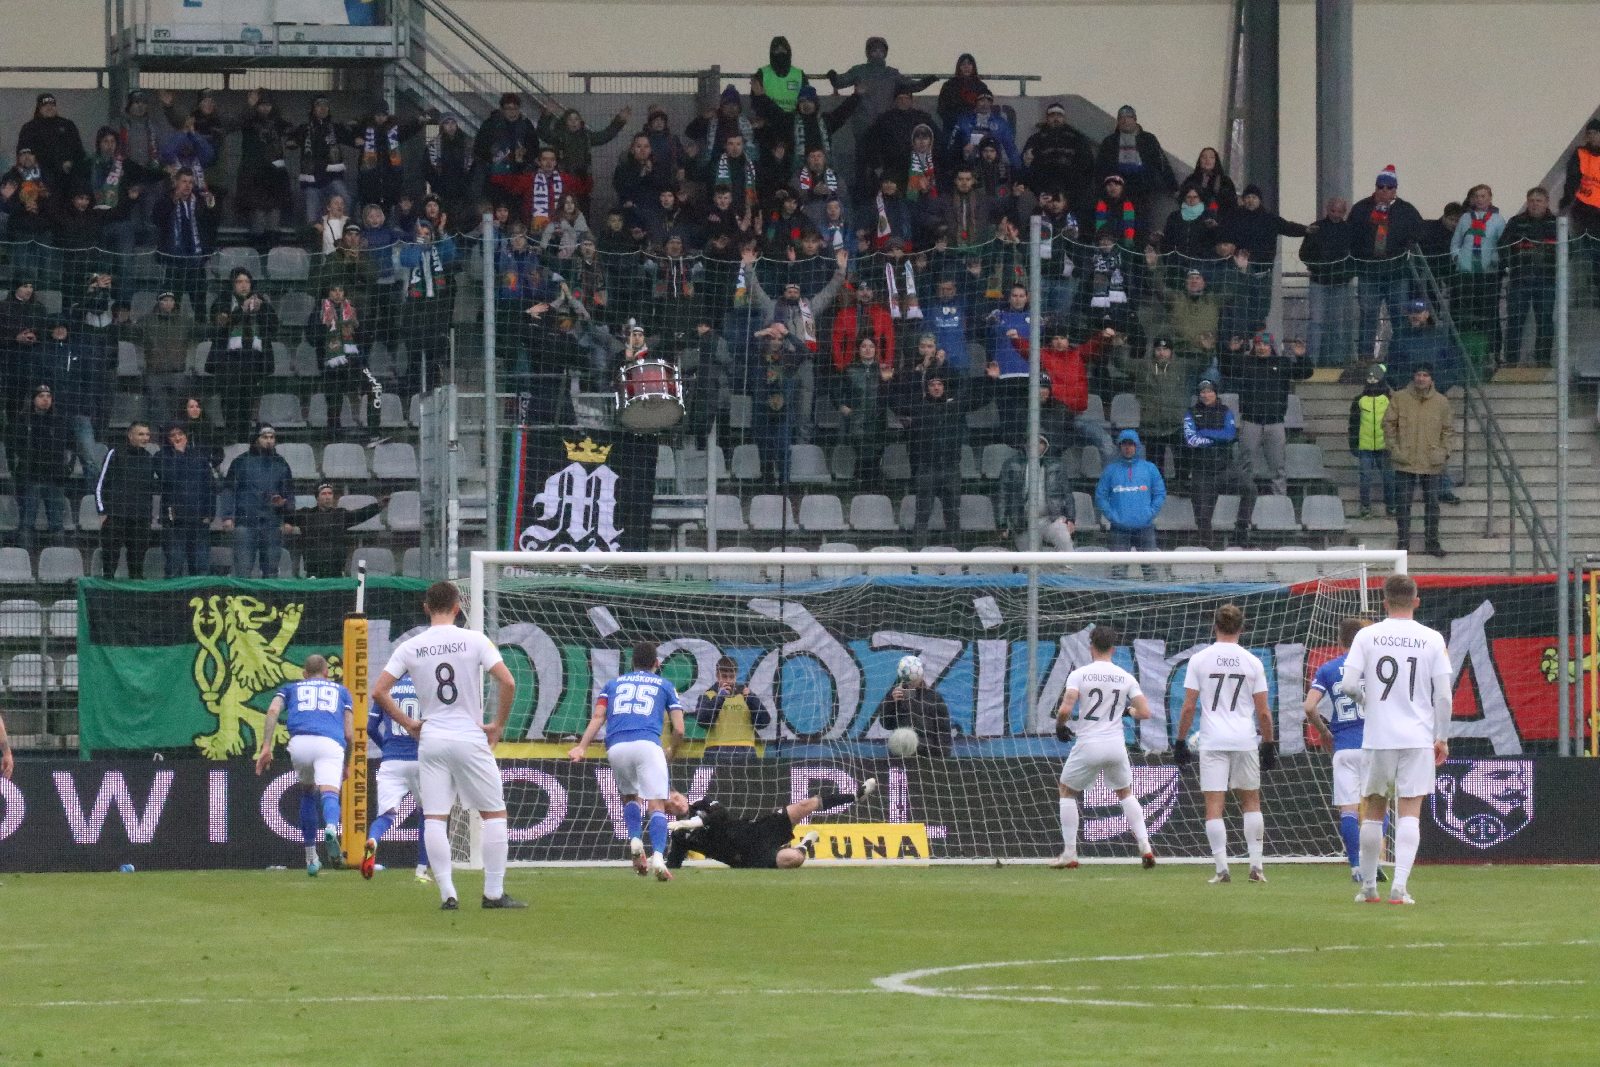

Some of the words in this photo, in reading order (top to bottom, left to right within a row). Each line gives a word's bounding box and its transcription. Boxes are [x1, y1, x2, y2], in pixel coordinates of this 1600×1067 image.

[1373, 635, 1428, 649] KOŚCIELNY
[355, 638, 368, 704] SPORT
[435, 662, 458, 705] 8
[1375, 655, 1418, 702] 91
[297, 685, 339, 713] 99
[613, 683, 659, 716] 25
[1084, 688, 1120, 722] 21
[1209, 673, 1246, 712] 77
[354, 728, 368, 834] TRANSFER
[803, 835, 921, 858] TUNA
